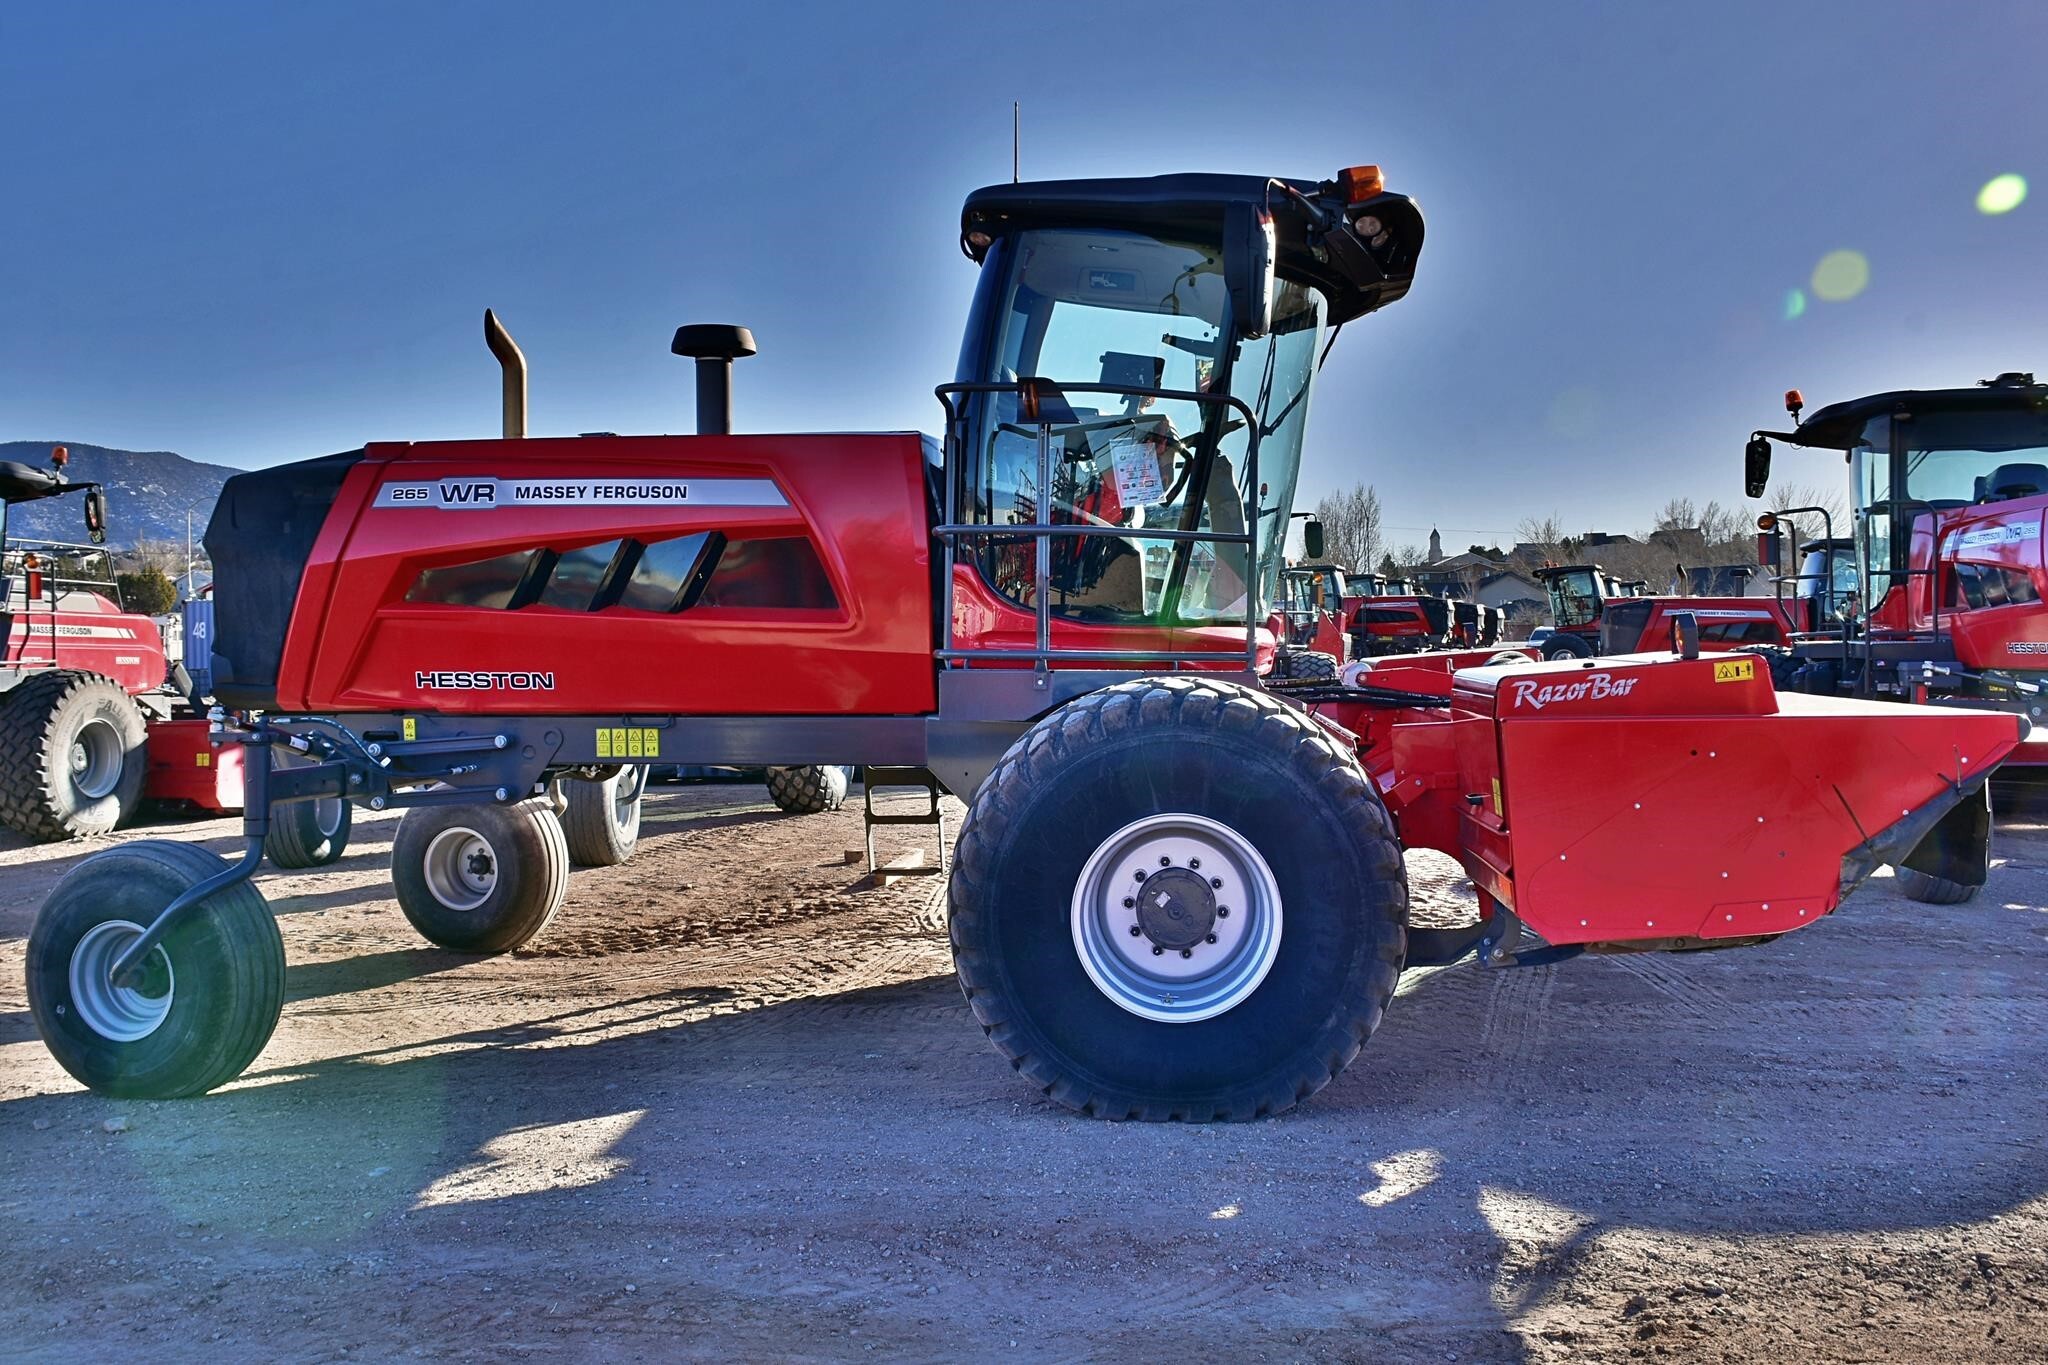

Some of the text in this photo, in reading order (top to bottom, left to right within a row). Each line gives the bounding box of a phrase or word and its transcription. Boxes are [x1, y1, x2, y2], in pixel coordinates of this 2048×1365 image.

[392, 483, 688, 503] 265 WR MASSEY FERGUSON
[192, 621, 206, 639] 48
[2006, 641, 2048, 654] HESSTO
[415, 671, 555, 690] HESSTON
